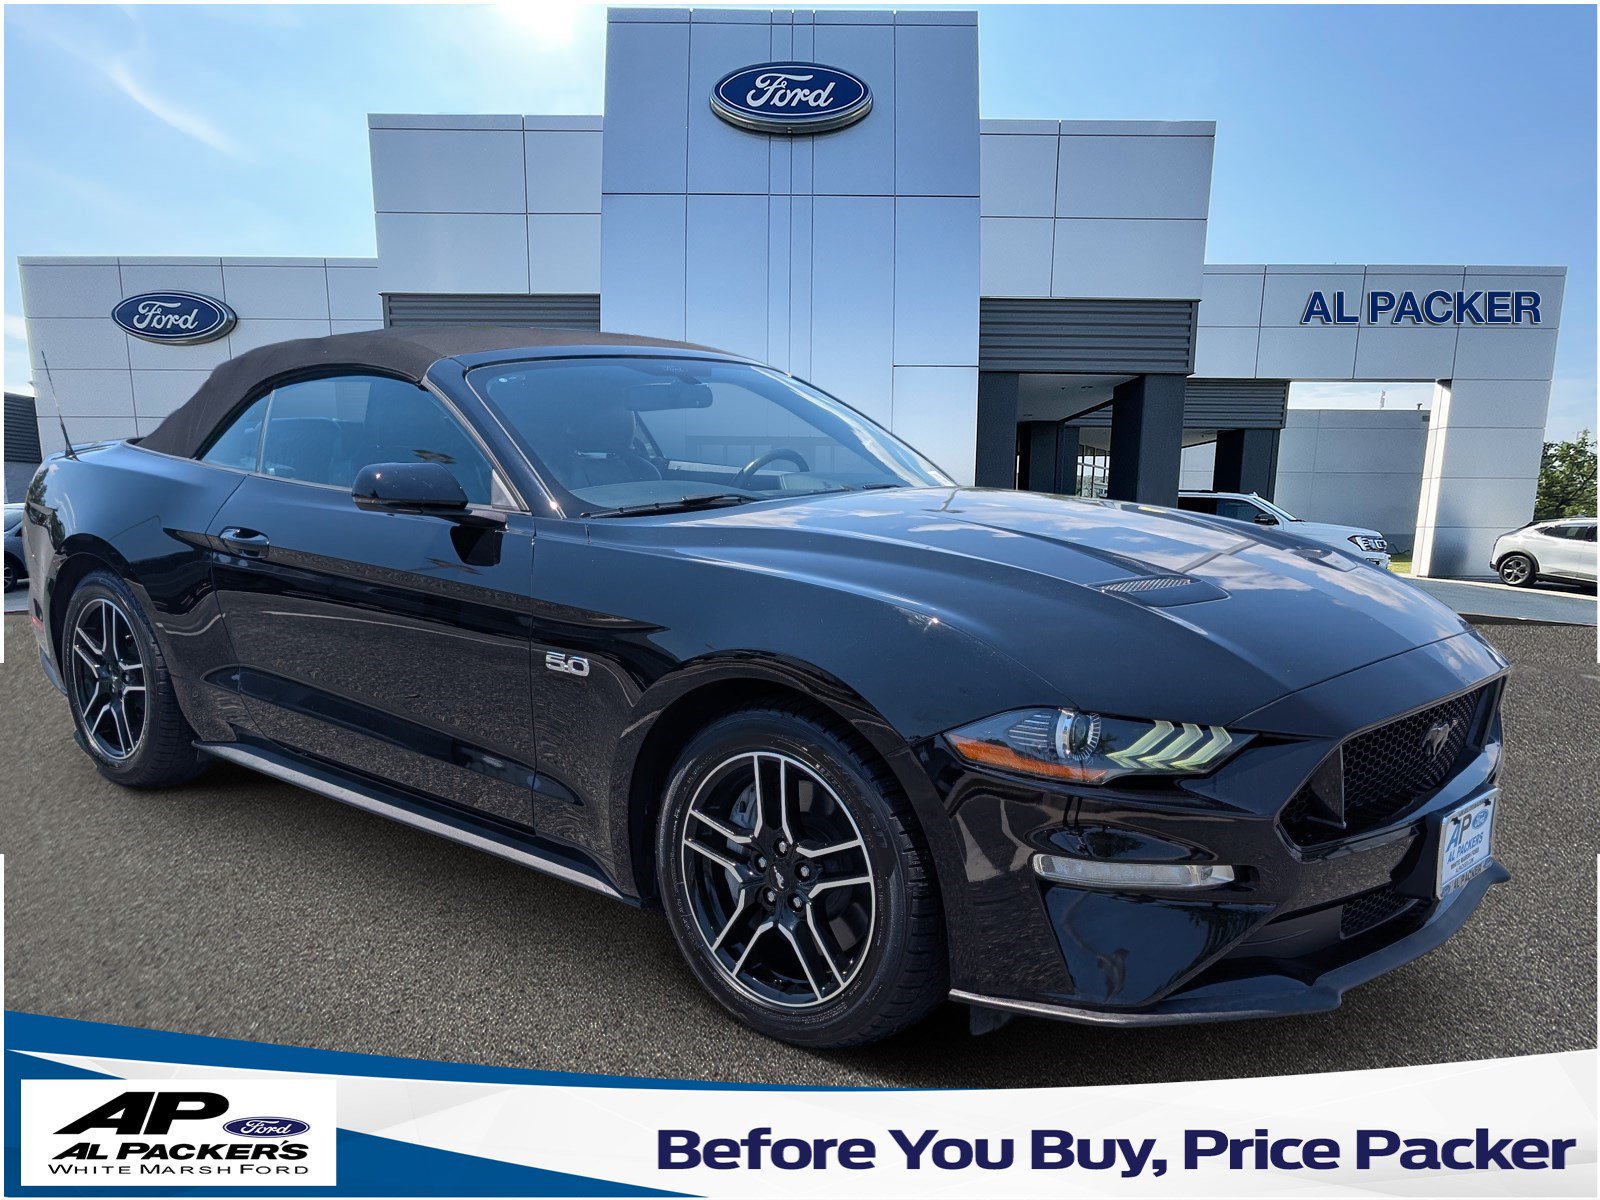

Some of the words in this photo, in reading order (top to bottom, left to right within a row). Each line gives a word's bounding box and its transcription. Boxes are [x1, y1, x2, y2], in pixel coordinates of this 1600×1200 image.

[746, 73, 836, 108] Ford
[133, 301, 199, 330] Ford
[1302, 291, 1360, 324] AL
[1368, 290, 1543, 324] PACKER
[545, 651, 590, 677] 5.0
[1446, 813, 1472, 852] AP
